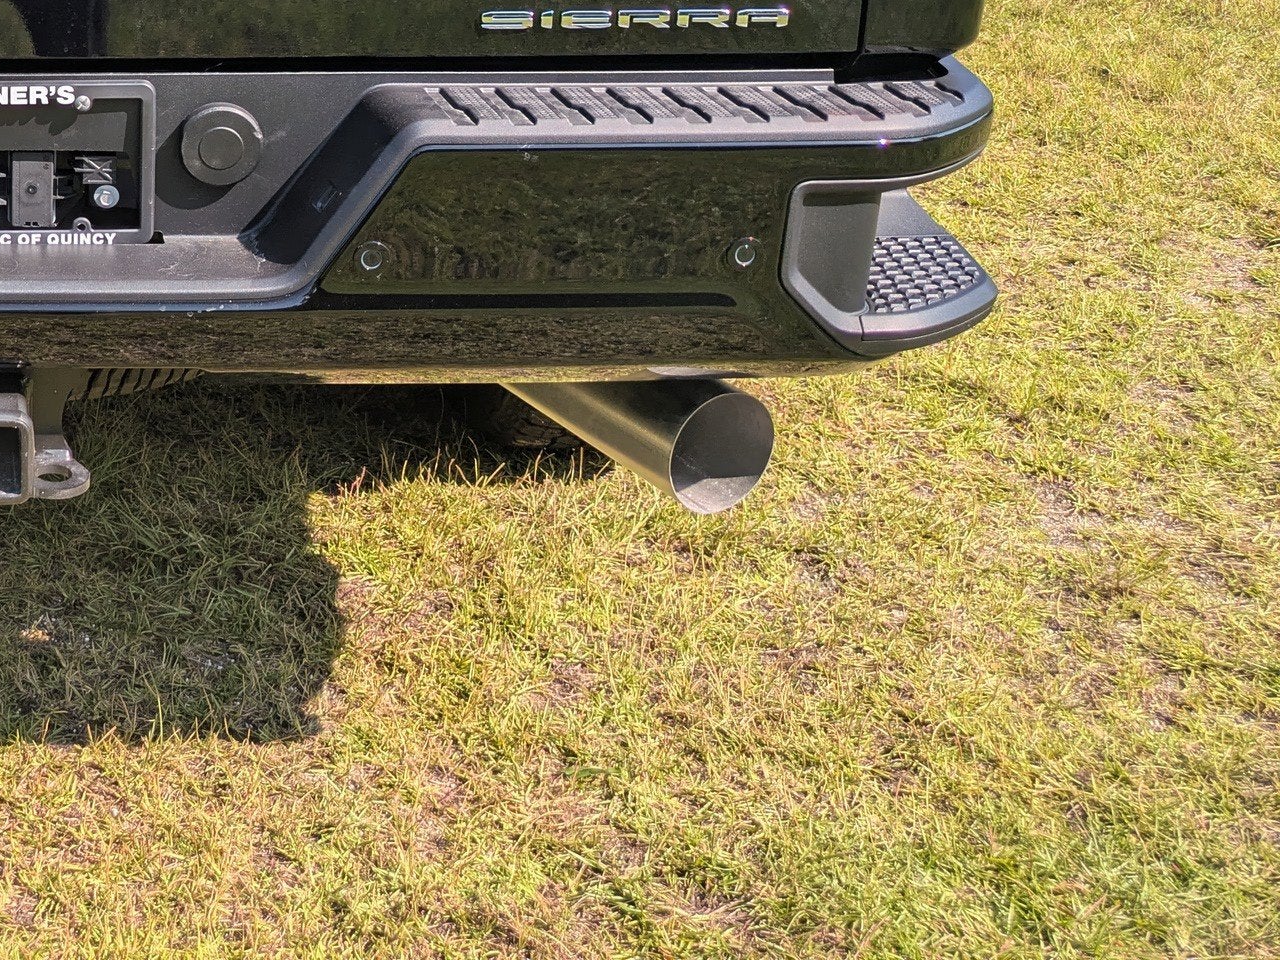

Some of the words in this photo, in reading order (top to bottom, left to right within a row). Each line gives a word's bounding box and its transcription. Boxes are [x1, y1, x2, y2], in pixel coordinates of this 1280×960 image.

[481, 8, 789, 29] SIERRA
[17, 233, 41, 245] OF
[46, 232, 117, 245] QUINCY
